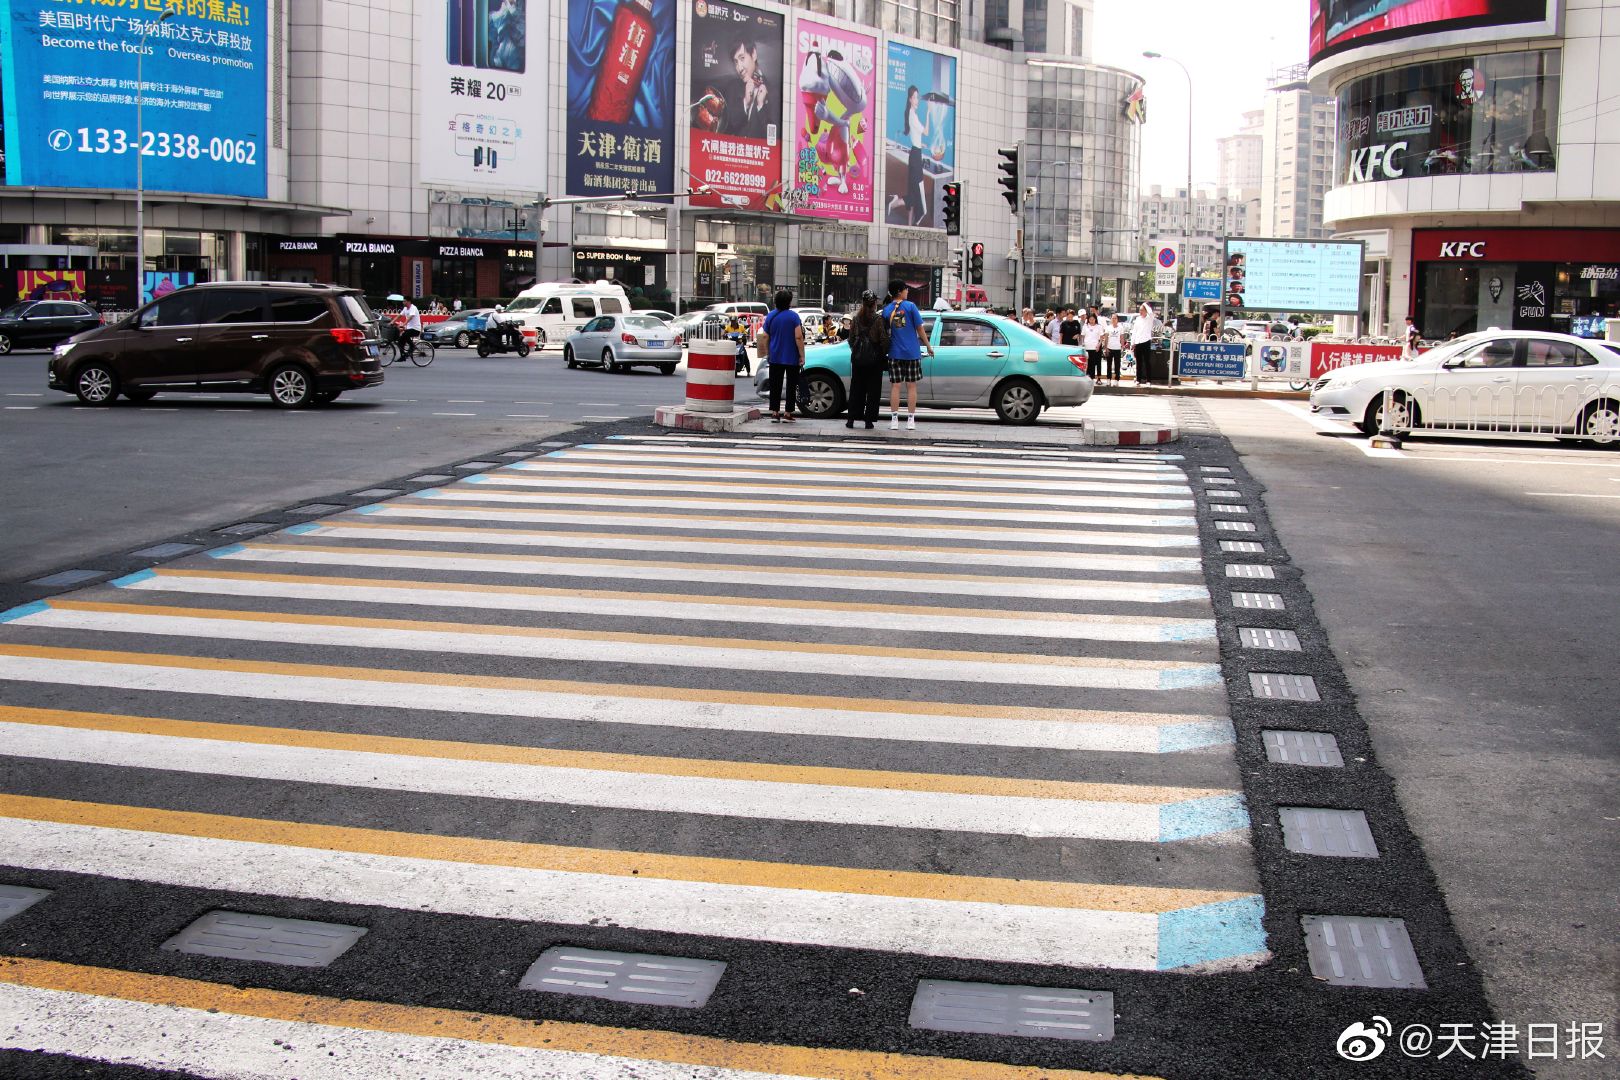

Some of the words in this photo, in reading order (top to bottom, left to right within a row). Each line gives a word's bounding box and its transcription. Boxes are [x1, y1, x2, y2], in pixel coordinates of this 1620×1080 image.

[39, 10, 252, 52] 美国时代广场纳斯达克大屏投放
[42, 35, 94, 50] Become
[98, 39, 118, 52] the
[121, 40, 154, 55] focus
[168, 48, 210, 62] Overseas
[212, 56, 254, 70] promotion
[450, 76, 481, 98] 荣耀
[486, 82, 505, 101] 20
[78, 127, 256, 165] 133-2338-0062
[1348, 142, 1408, 184] KFC
[706, 169, 766, 187] 022-66228999
[296, 242, 318, 250] BIANCA
[346, 243, 367, 252] PIZZA
[369, 243, 394, 254] BIANCA
[440, 246, 458, 256] PIZZA
[460, 247, 484, 257] BIANCA
[1440, 242, 1486, 257] KFC
[586, 252, 605, 260] SUPER
[625, 254, 641, 262] Burger
[1580, 268, 1618, 280] 甜品站
[1520, 306, 1545, 317] FUN
